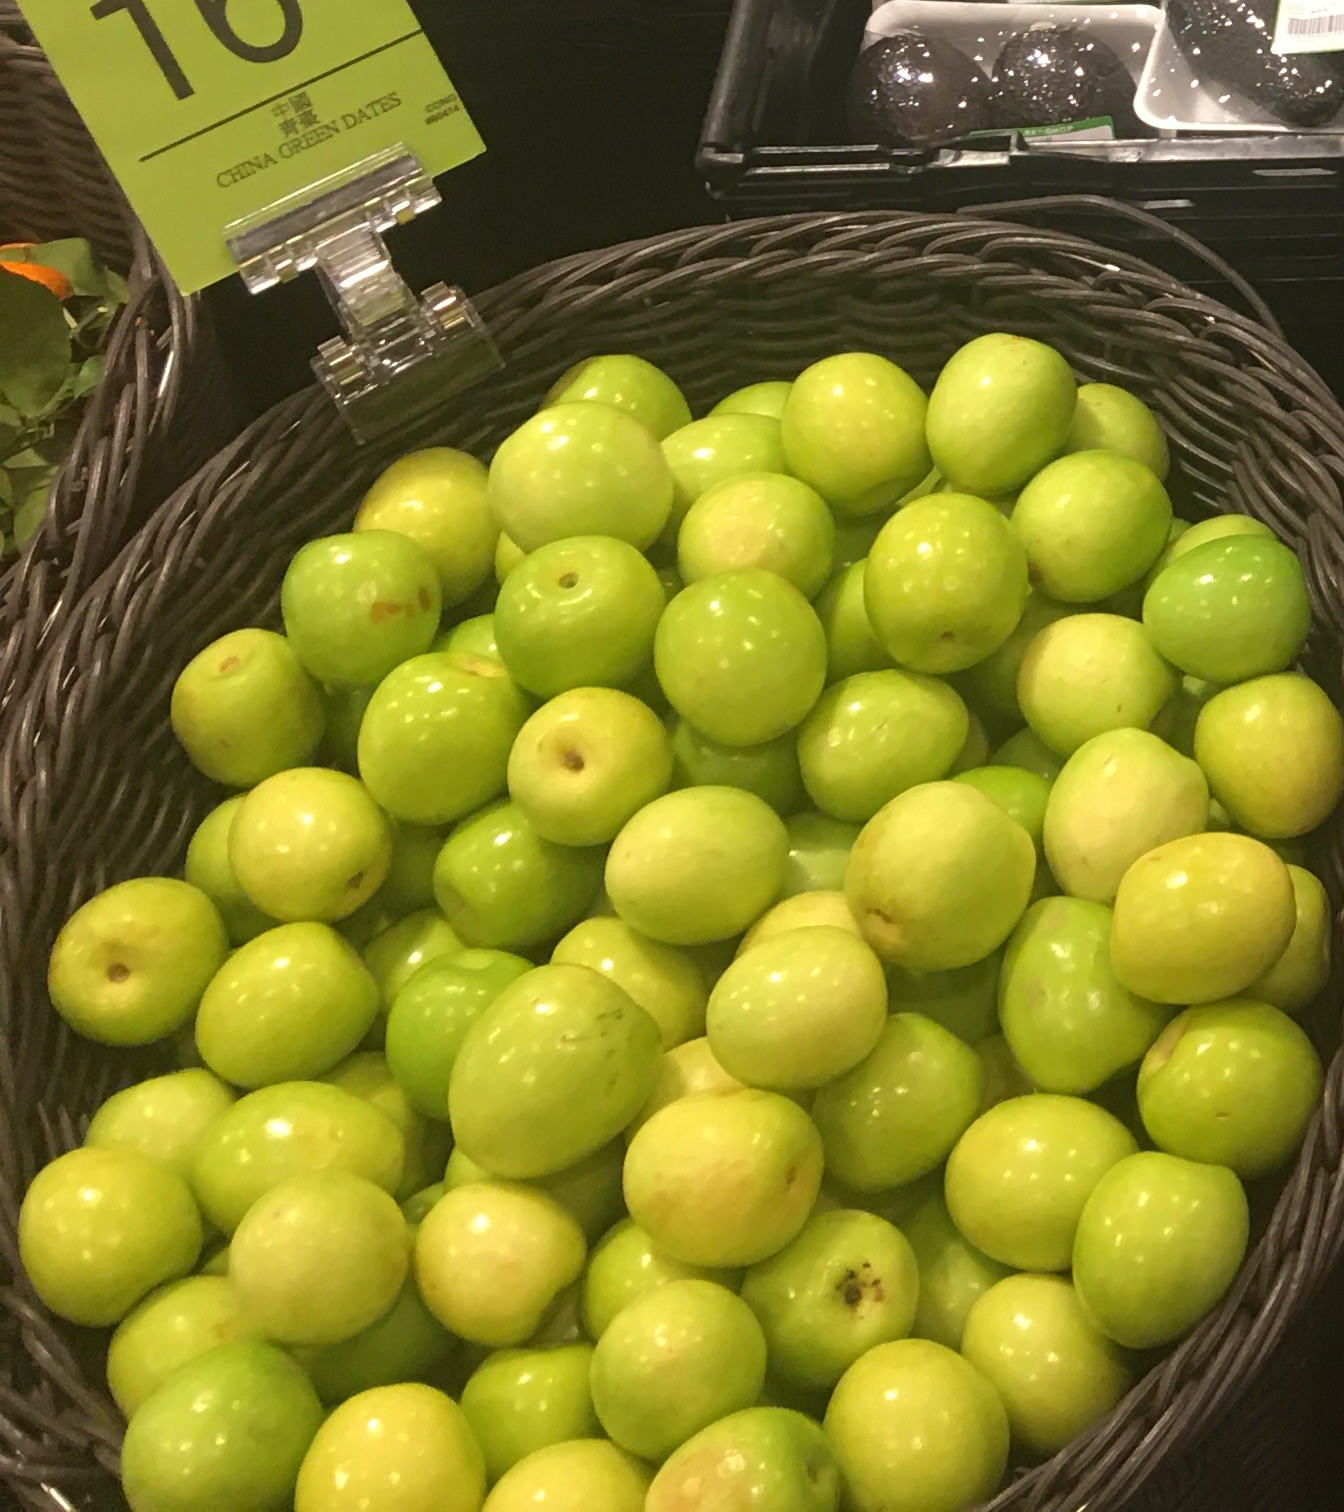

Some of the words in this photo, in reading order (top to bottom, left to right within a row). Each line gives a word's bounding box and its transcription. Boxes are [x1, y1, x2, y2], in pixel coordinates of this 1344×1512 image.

[216, 152, 279, 189] CHINA
[278, 120, 341, 160] GREEN
[341, 91, 403, 131] DATES
